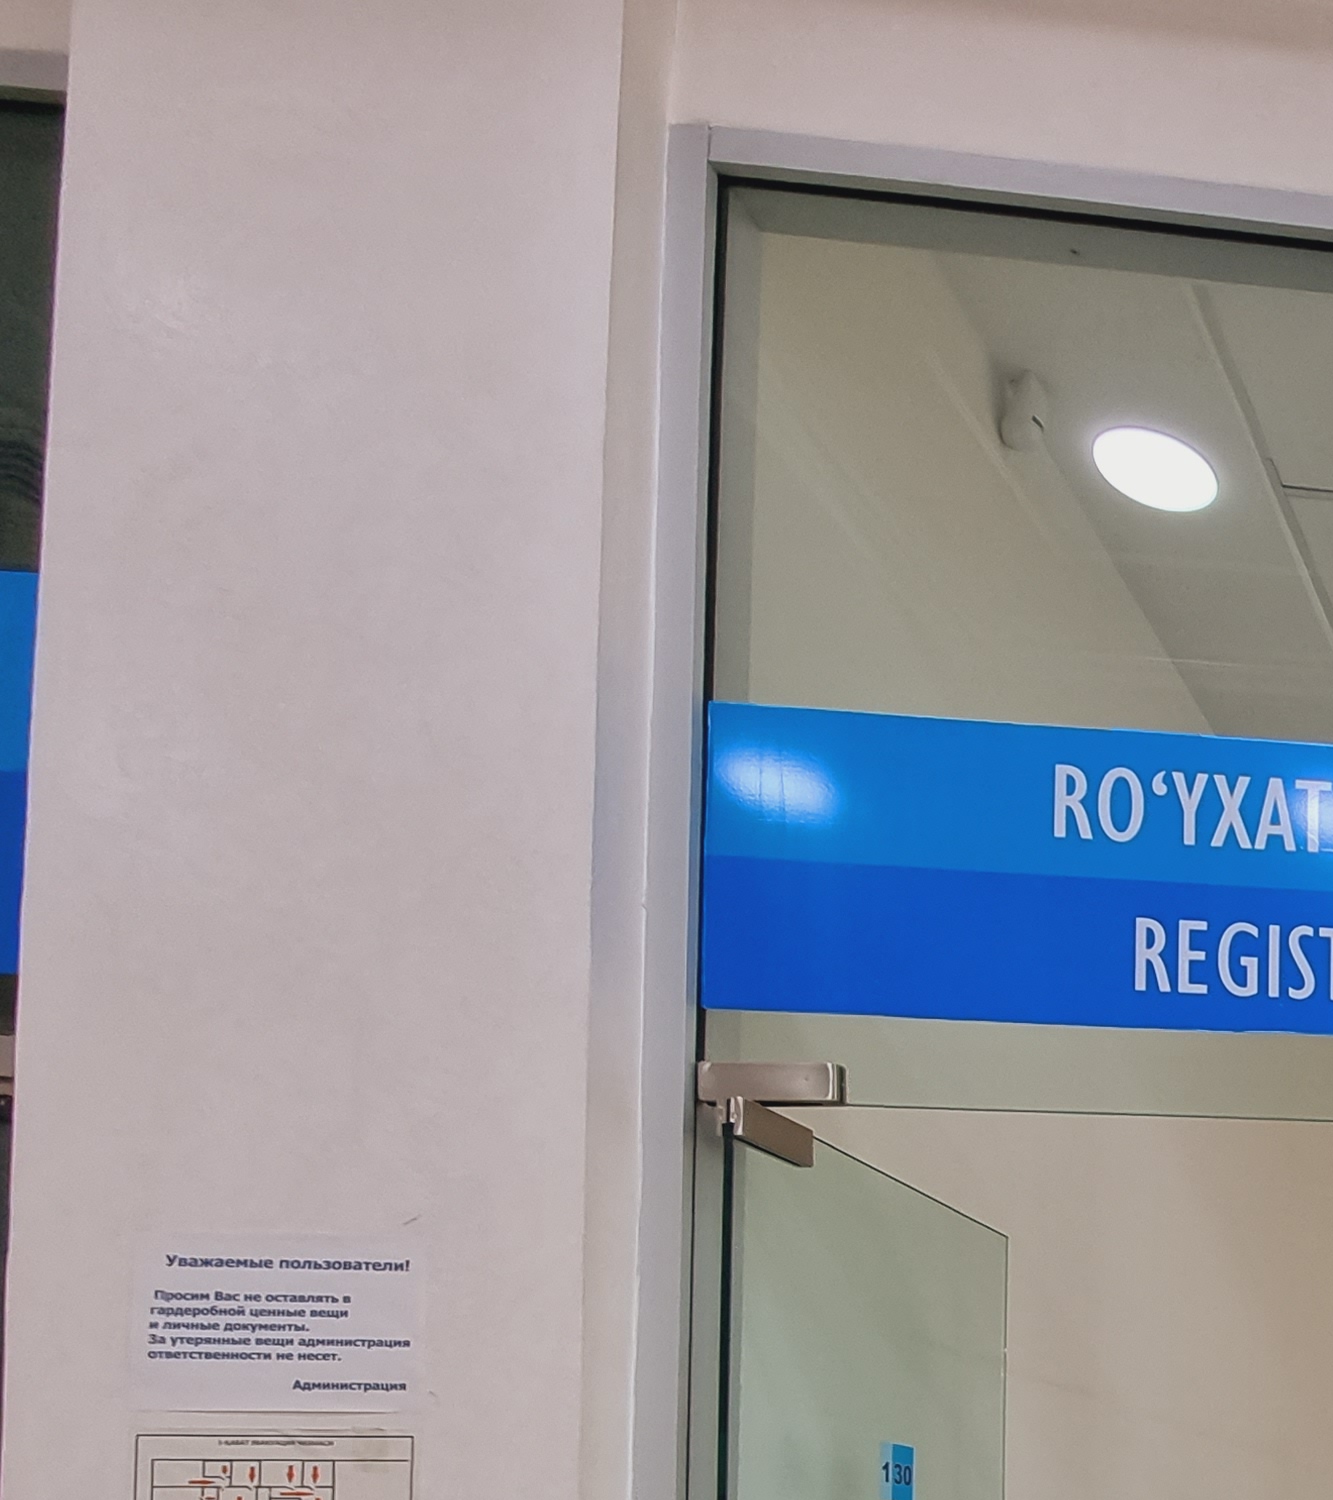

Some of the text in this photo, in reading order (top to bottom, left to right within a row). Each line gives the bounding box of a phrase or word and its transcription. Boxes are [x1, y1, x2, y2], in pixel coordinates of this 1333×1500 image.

[165, 1253, 411, 1273] Уважаемые пользователи!
[153, 1289, 352, 1304] Просим Вас не оставлять в
[150, 1305, 349, 1319] гардеробной ценные вещи
[149, 1321, 311, 1334] и личные документы.
[148, 1333, 411, 1349] За утерянные вещи администрация
[147, 1350, 342, 1362] ответственности не несет.
[292, 1379, 407, 1393] Администрация
[881, 1461, 912, 1486] 130
